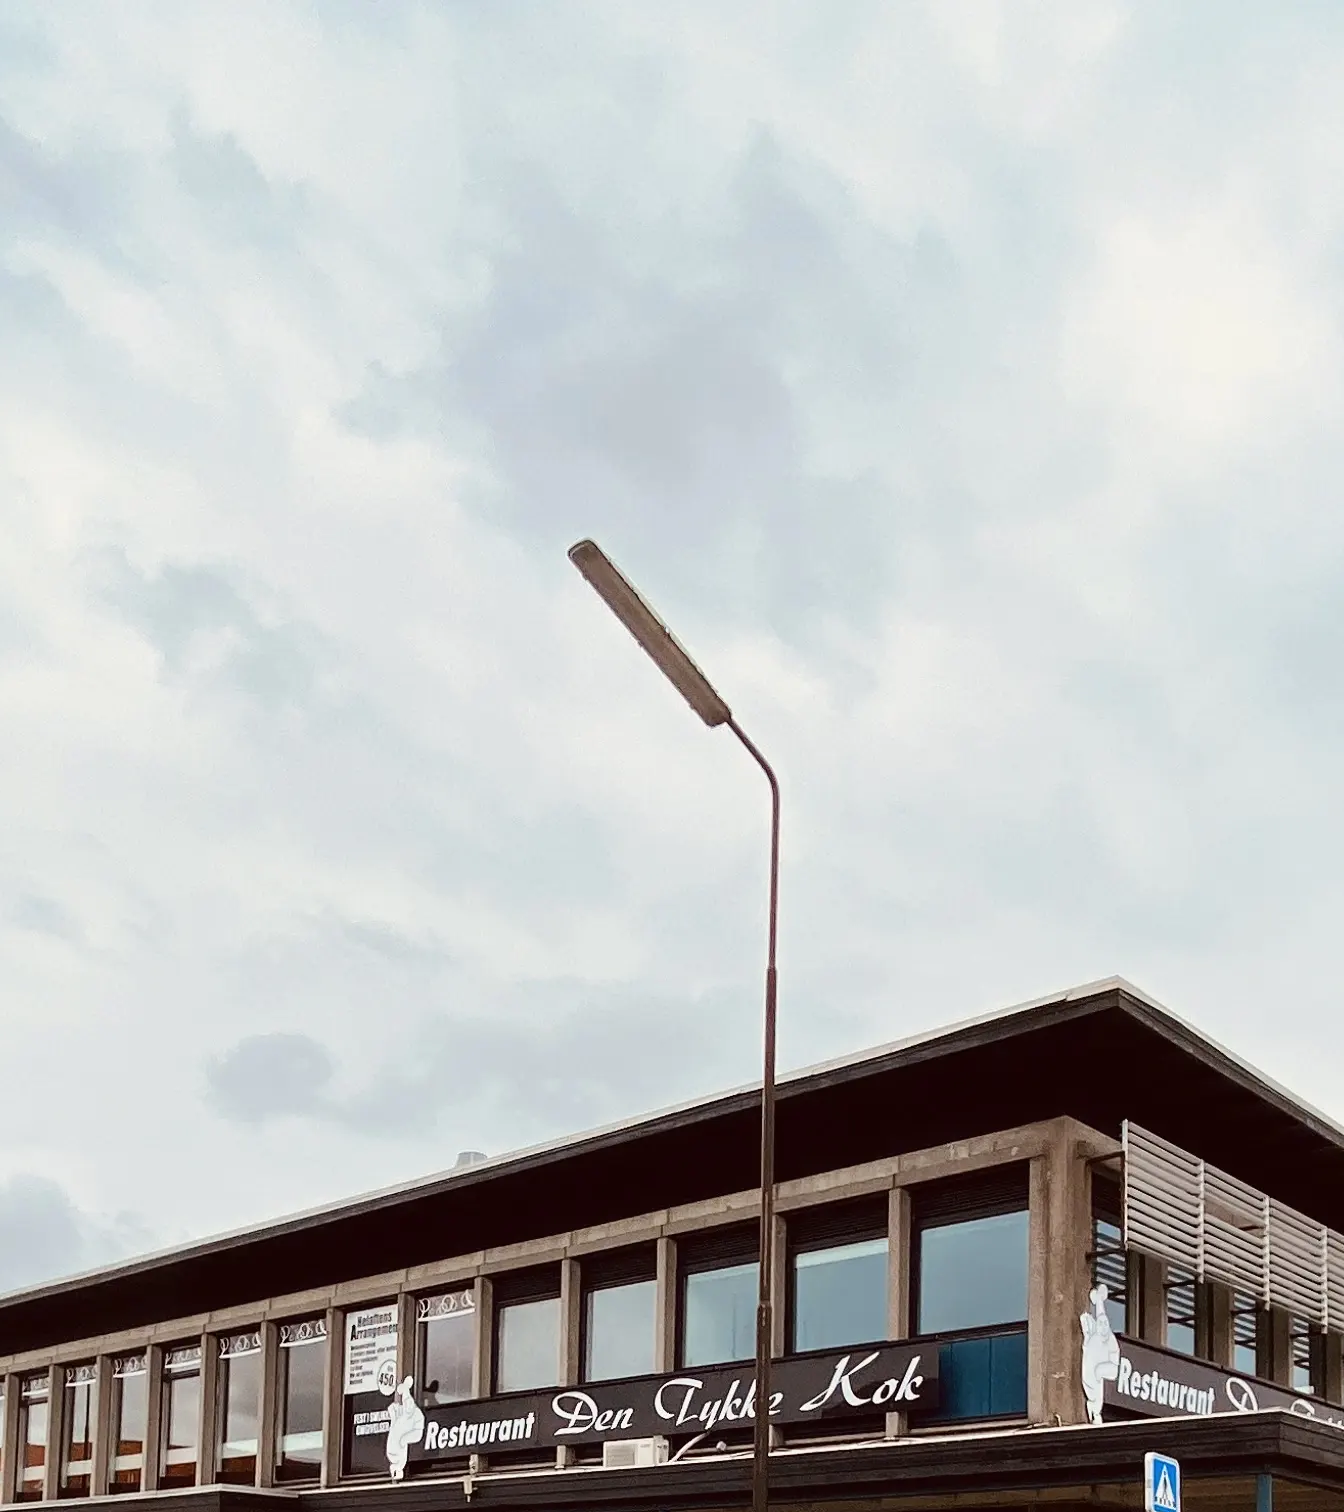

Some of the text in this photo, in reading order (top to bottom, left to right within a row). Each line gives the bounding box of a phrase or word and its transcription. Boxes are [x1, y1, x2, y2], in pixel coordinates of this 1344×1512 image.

[350, 1323, 398, 1341] Arrangemen
[378, 1372, 394, 1387] 450
[1117, 1356, 1216, 1415] Restaurant
[424, 1351, 924, 1450] Restaurant Den Tykke Kok
